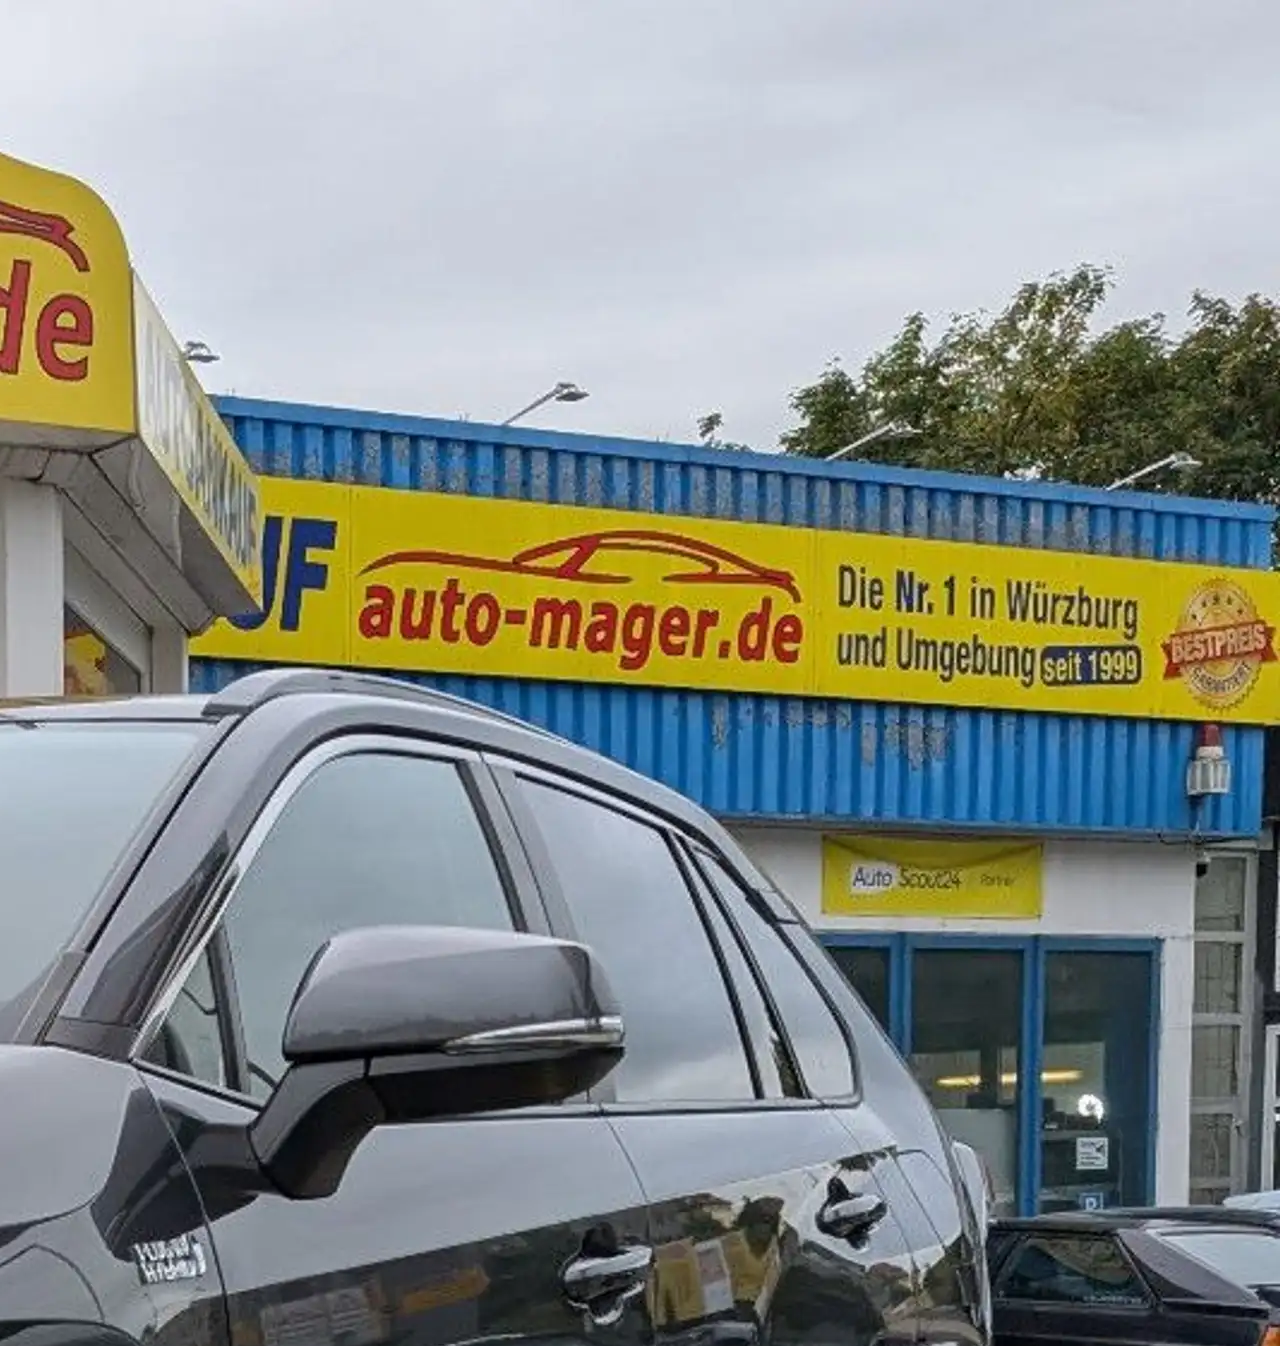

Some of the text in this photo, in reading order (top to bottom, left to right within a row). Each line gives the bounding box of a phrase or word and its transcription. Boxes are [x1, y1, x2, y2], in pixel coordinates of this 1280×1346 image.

[359, 577, 804, 670] auto-mager.de
[838, 565, 1139, 641] Die Nr. 1 in Würzburg
[837, 627, 1139, 689] und Umgebung seit 1999
[1170, 623, 1268, 665] BESTPREIS
